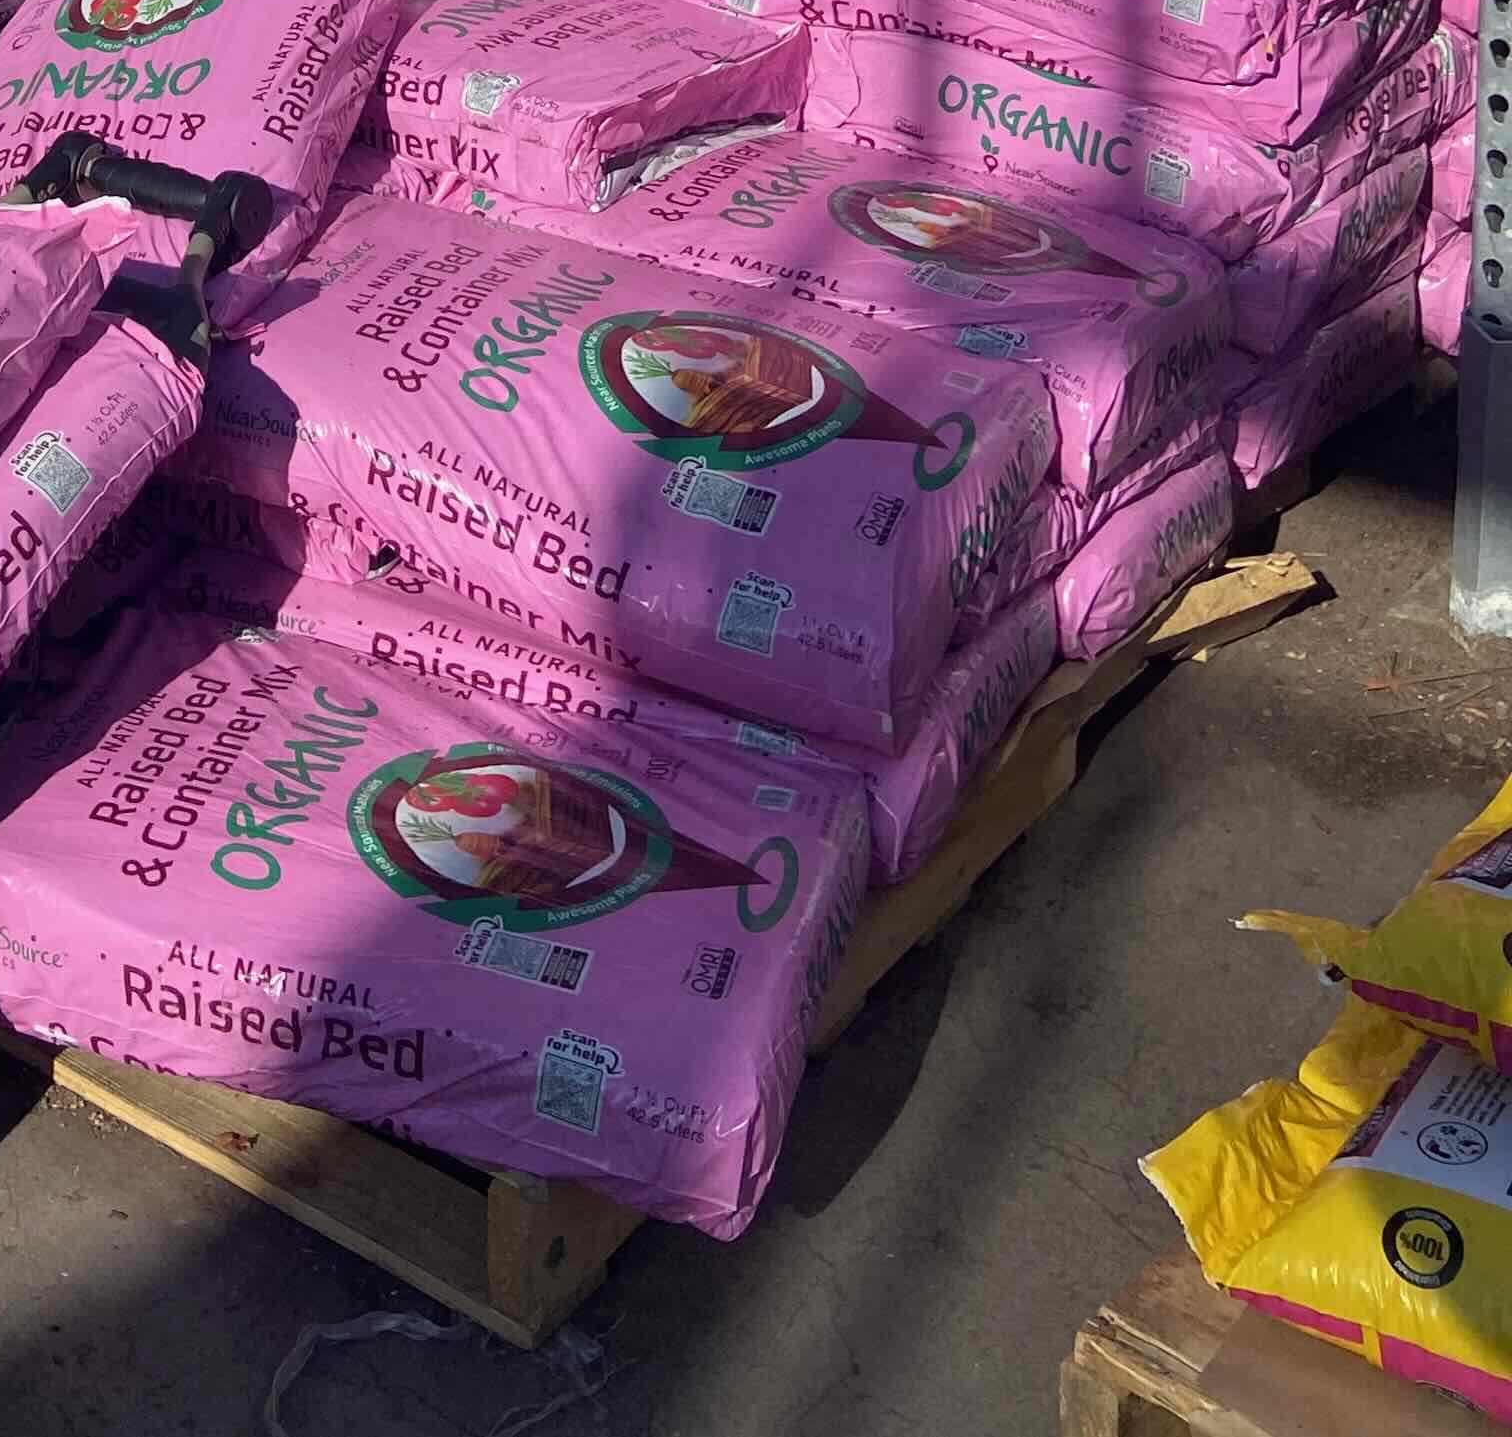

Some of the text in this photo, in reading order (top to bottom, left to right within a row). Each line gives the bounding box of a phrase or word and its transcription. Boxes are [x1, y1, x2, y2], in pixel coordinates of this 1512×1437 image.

[252, 4, 317, 102] ALL NATURAL
[263, 44, 332, 142] Raised
[938, 74, 1131, 176] ORGANIC
[459, 264, 615, 412] ORGANIC
[418, 440, 592, 537] ALL NATURAL
[662, 469, 679, 496] Scan
[744, 418, 844, 466] Awesome Plants
[367, 450, 630, 603] Raised Bed
[242, 663, 304, 704] Mix
[210, 686, 379, 891] ORGANIC
[690, 947, 724, 995] OMRI
[122, 963, 425, 1081] Raised Bed
[546, 1037, 607, 1069] for help
[1399, 1231, 1445, 1262] 100%
